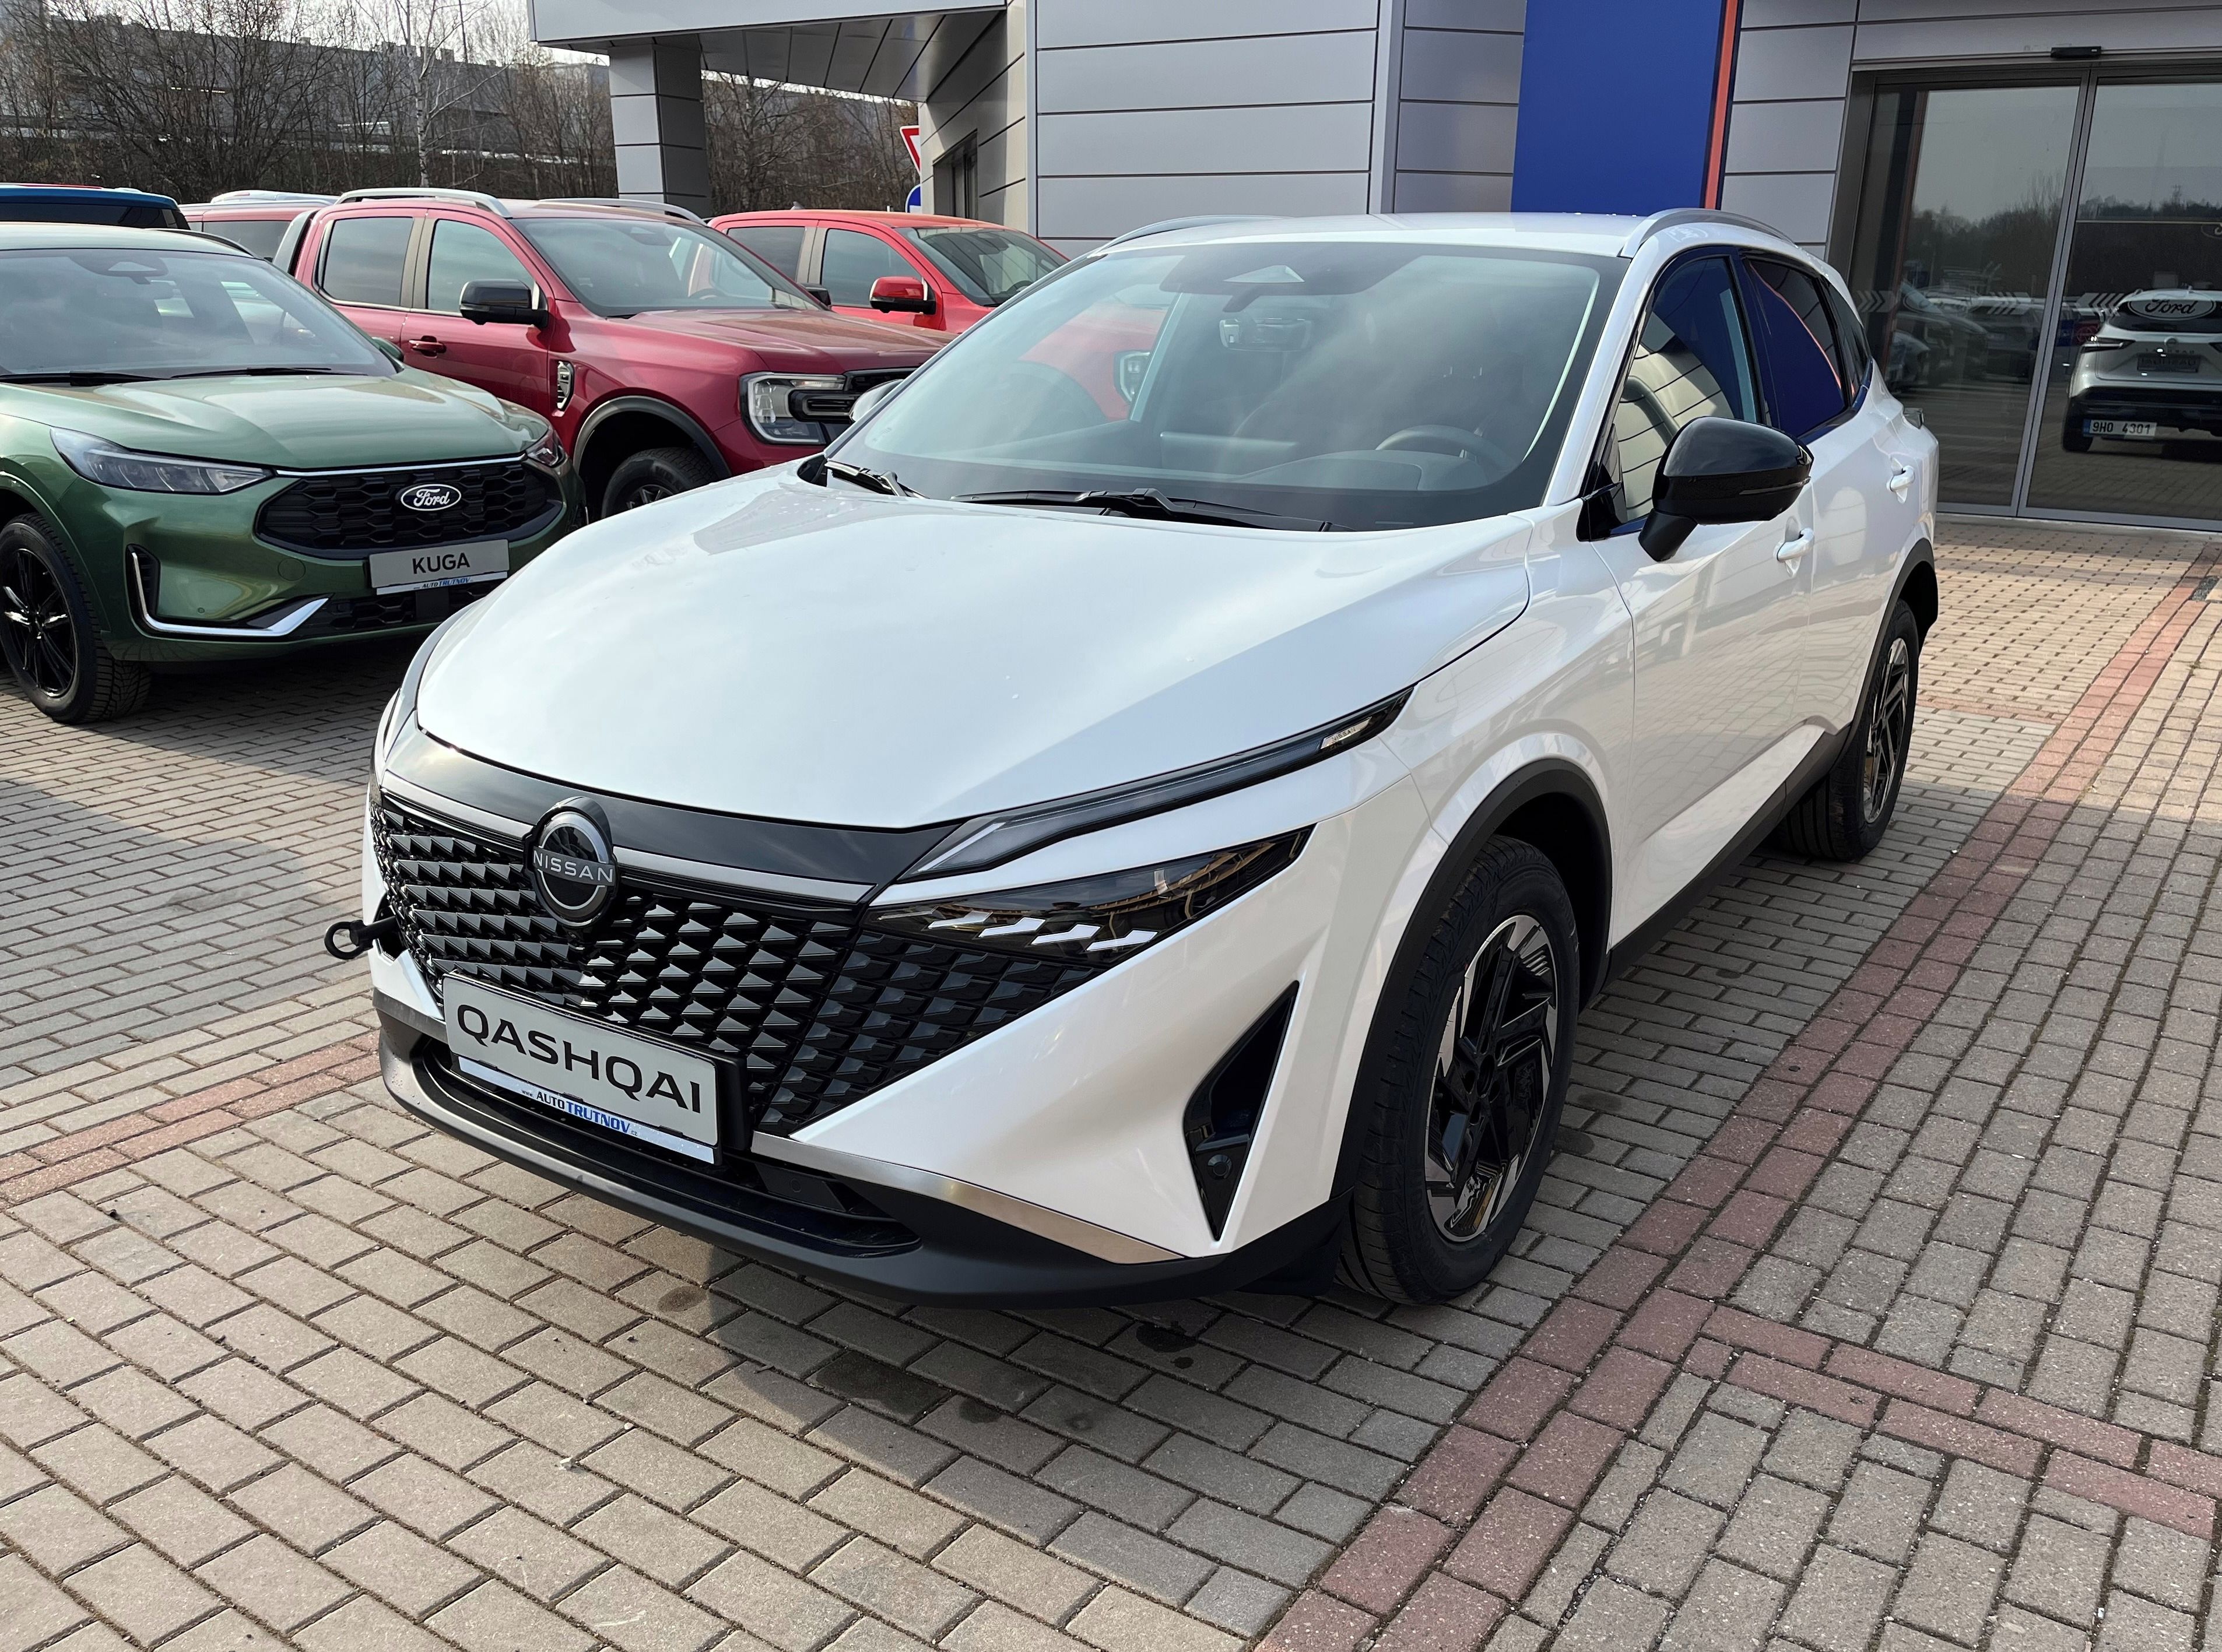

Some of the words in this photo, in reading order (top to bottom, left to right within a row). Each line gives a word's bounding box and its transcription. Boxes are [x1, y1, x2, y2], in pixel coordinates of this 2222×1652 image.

[2144, 294, 2198, 314] Ford
[2122, 423, 2151, 434] 4301
[413, 488, 450, 507] Ford
[412, 552, 471, 574] KUGA
[439, 577, 471, 586] TRUTNOV
[1331, 727, 1356, 741] NISSAN
[533, 850, 613, 883] NISSAN
[457, 1004, 700, 1113] QASHQAI
[536, 1091, 565, 1110] AUTO
[566, 1101, 630, 1133] TRUTNOV
